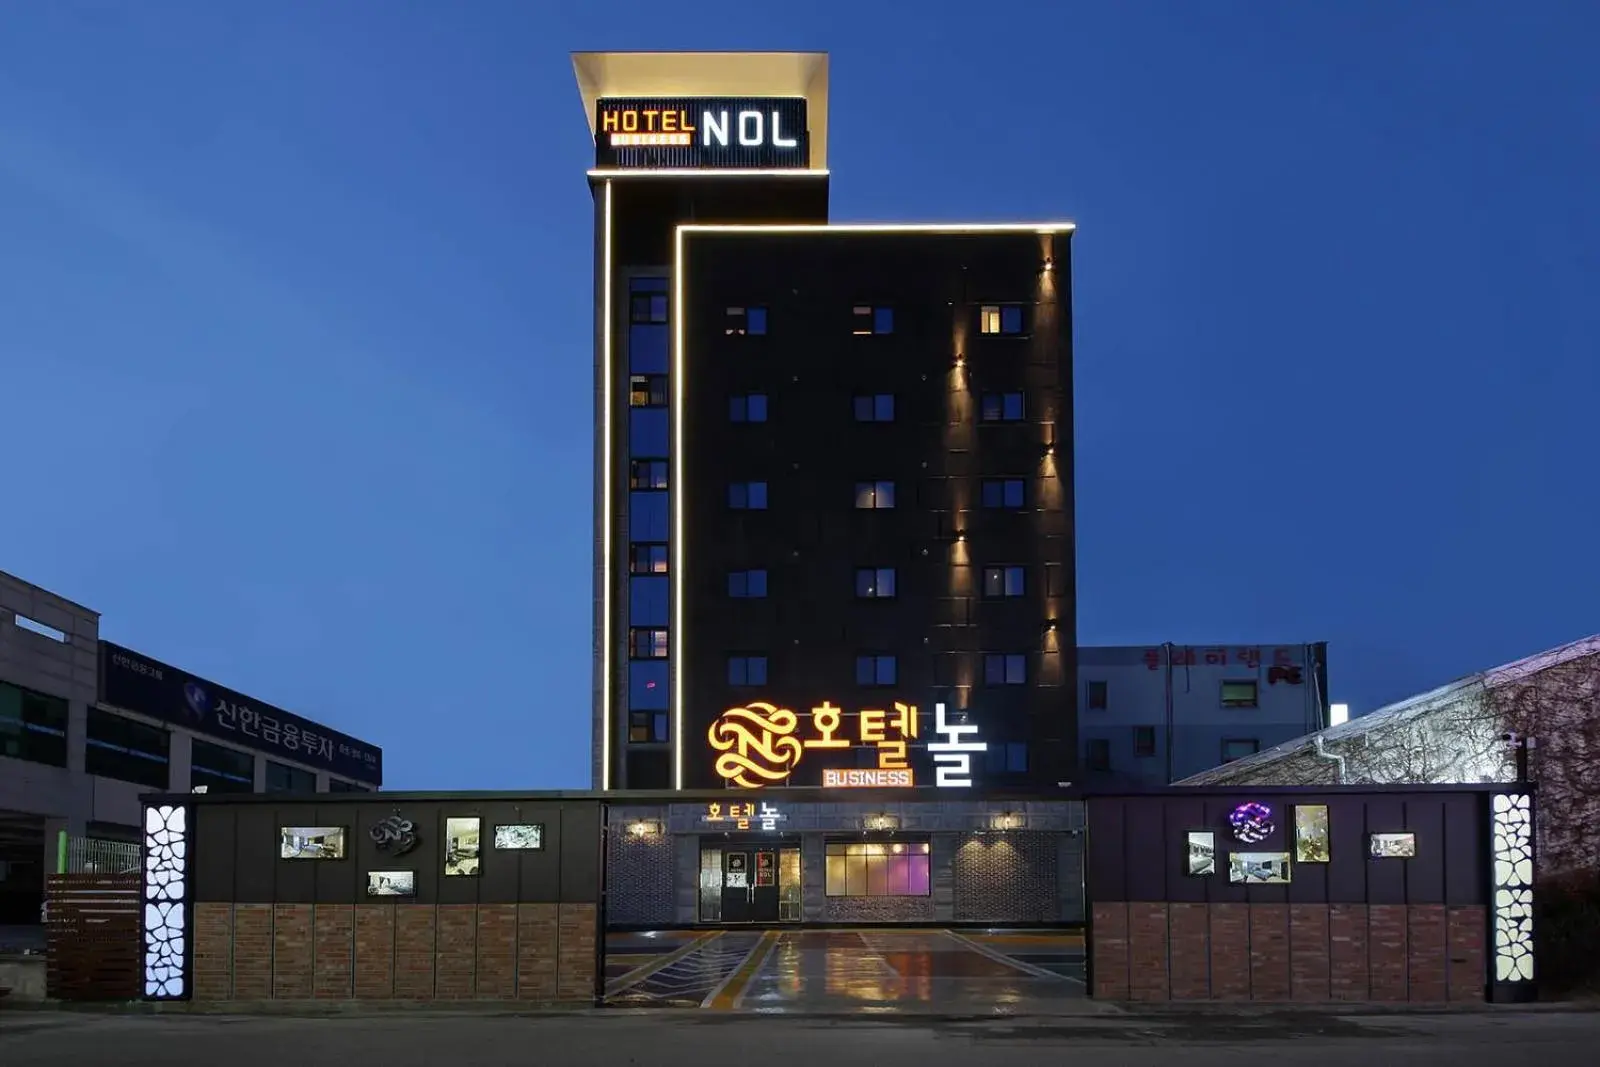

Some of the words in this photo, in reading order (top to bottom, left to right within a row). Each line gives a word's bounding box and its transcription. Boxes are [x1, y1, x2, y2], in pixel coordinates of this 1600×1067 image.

[603, 110, 696, 132] HOTEL
[703, 110, 797, 147] NOL
[215, 698, 335, 763] 신한금융투자
[803, 701, 918, 768] 호텔
[927, 702, 988, 787] 놀
[825, 770, 911, 786] BUSINESS
[706, 802, 755, 829] 호텔
[759, 802, 780, 830] 놀
